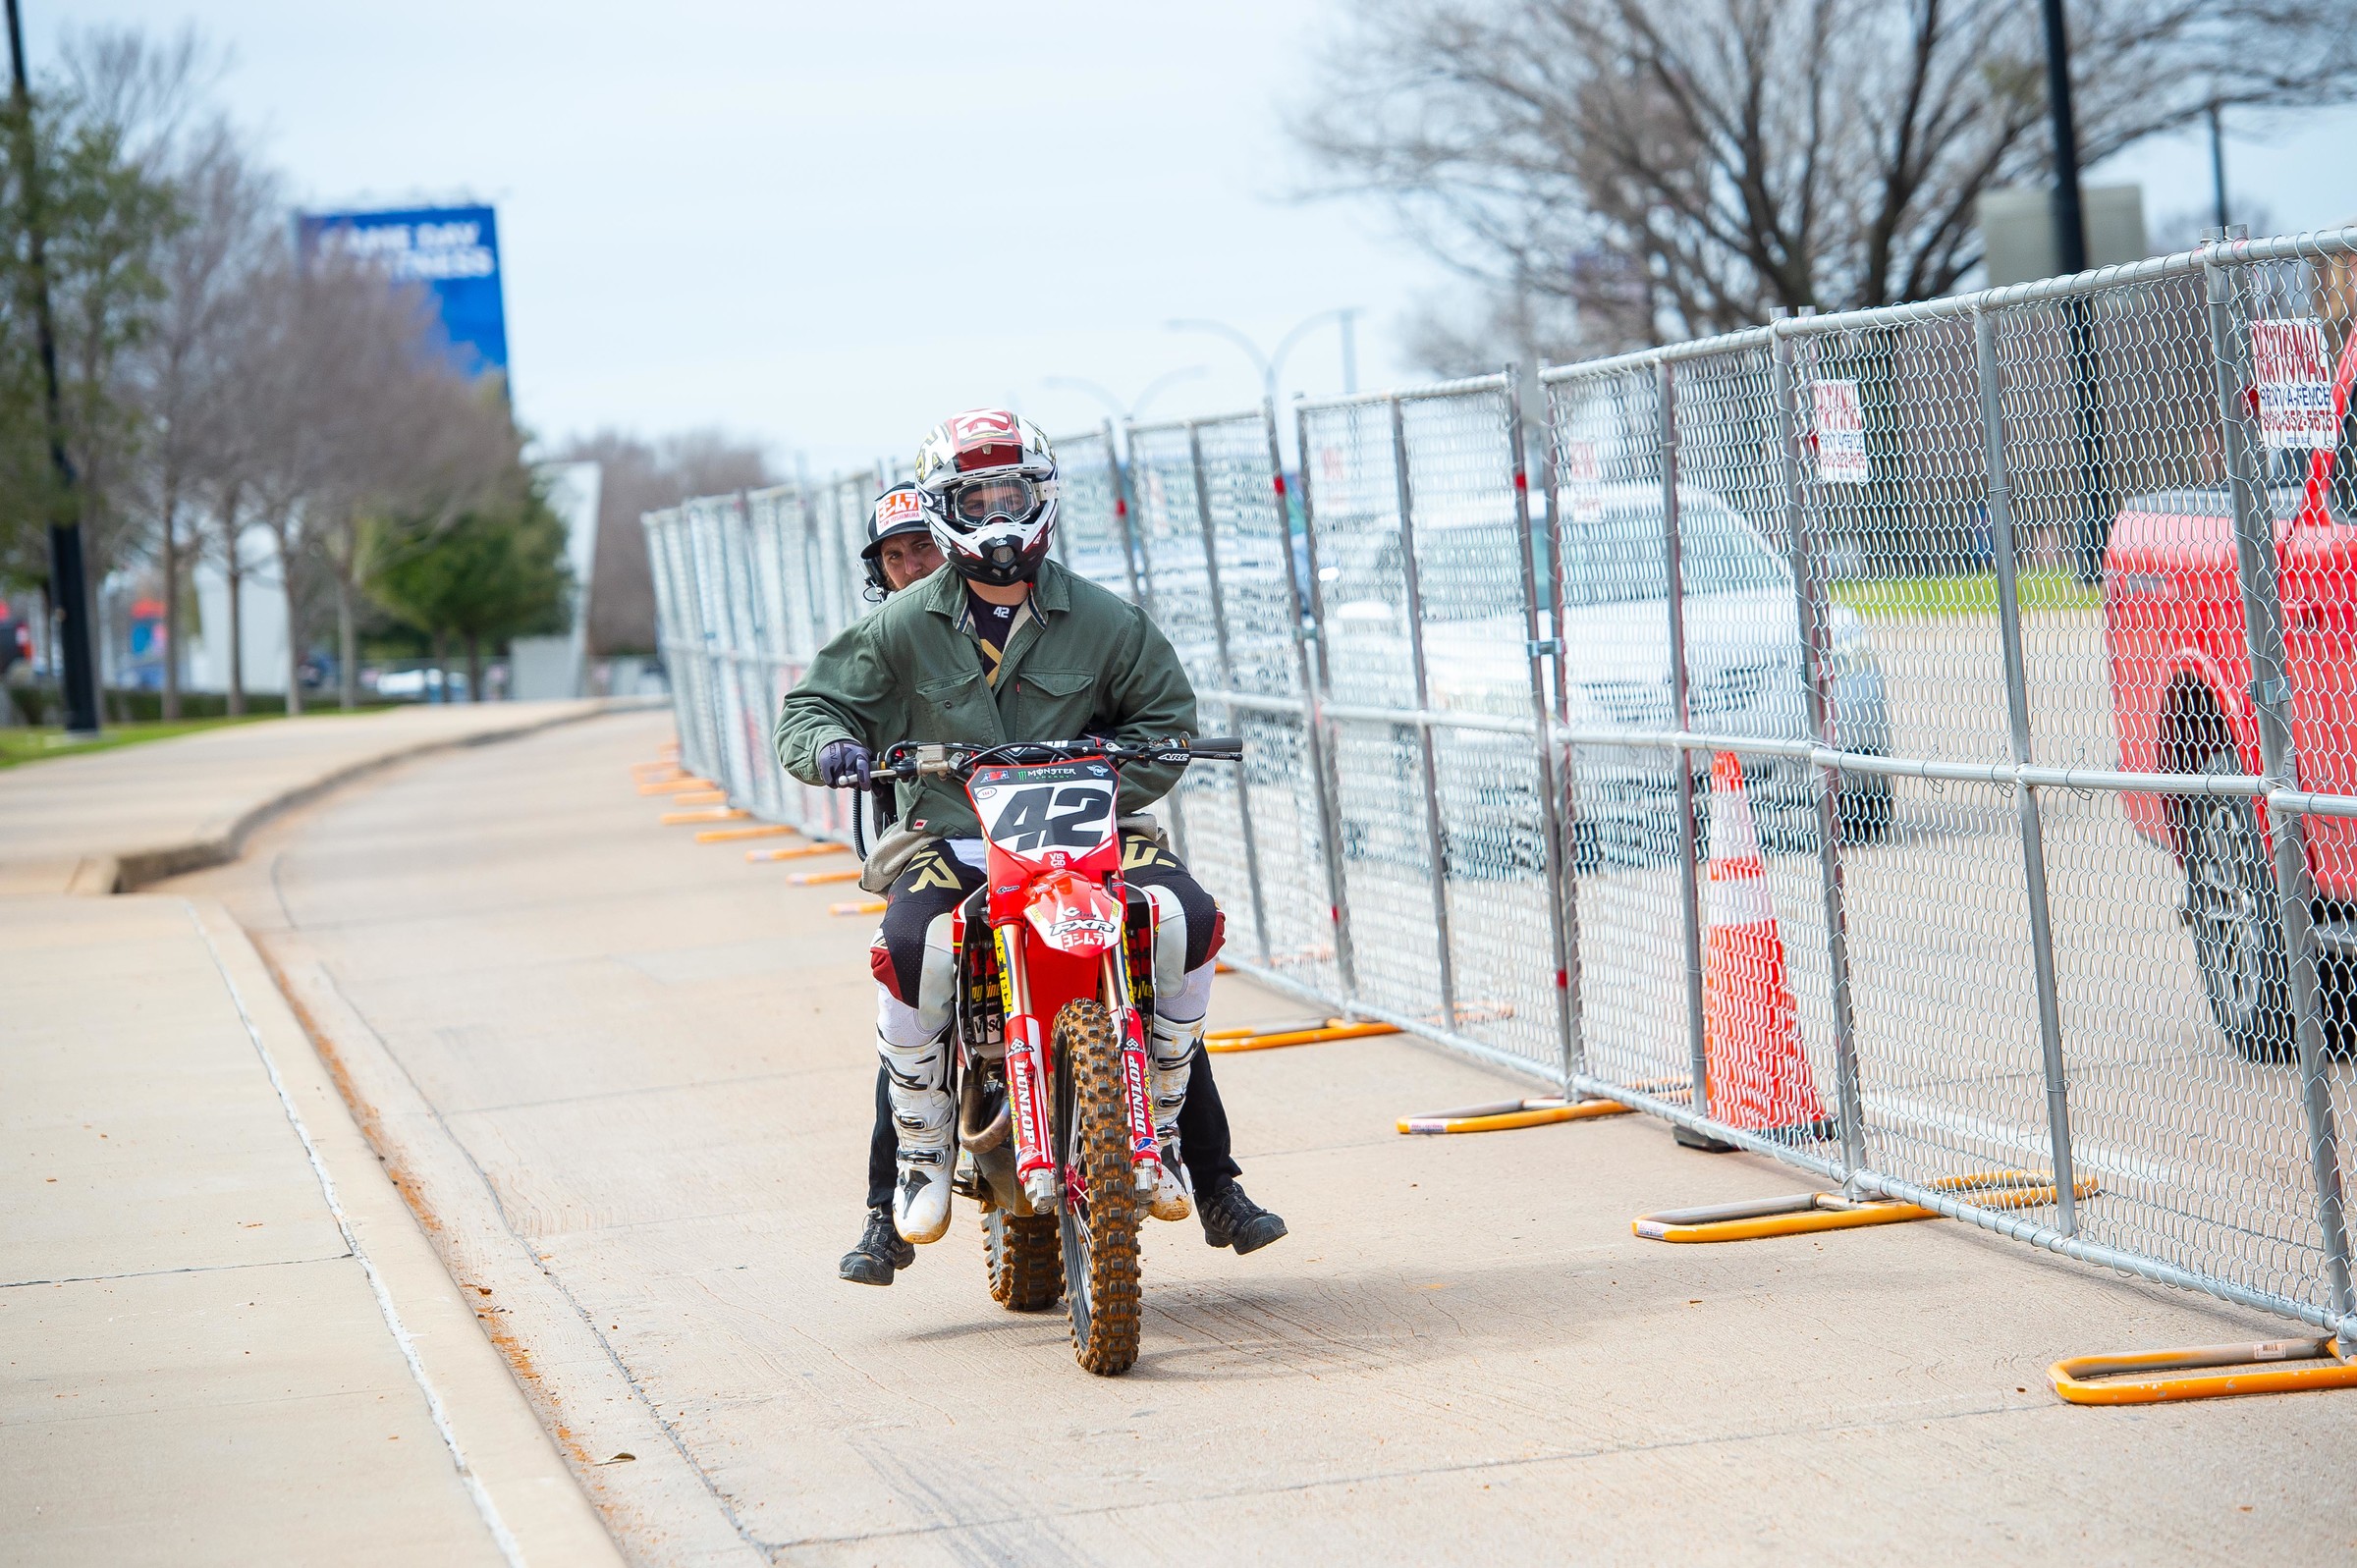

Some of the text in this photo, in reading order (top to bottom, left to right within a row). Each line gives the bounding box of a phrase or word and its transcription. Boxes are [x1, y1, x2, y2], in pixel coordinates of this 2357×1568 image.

[993, 606, 1010, 619] 42
[1158, 752, 1189, 762] ARC
[1027, 767, 1076, 778] MONSTER
[991, 786, 1112, 853] 42
[1050, 918, 1116, 936] FXR
[1063, 932, 1104, 948] ヨシムラ
[1014, 1058, 1035, 1144] DUNLOP
[1127, 1054, 1146, 1135] DUNLOP
